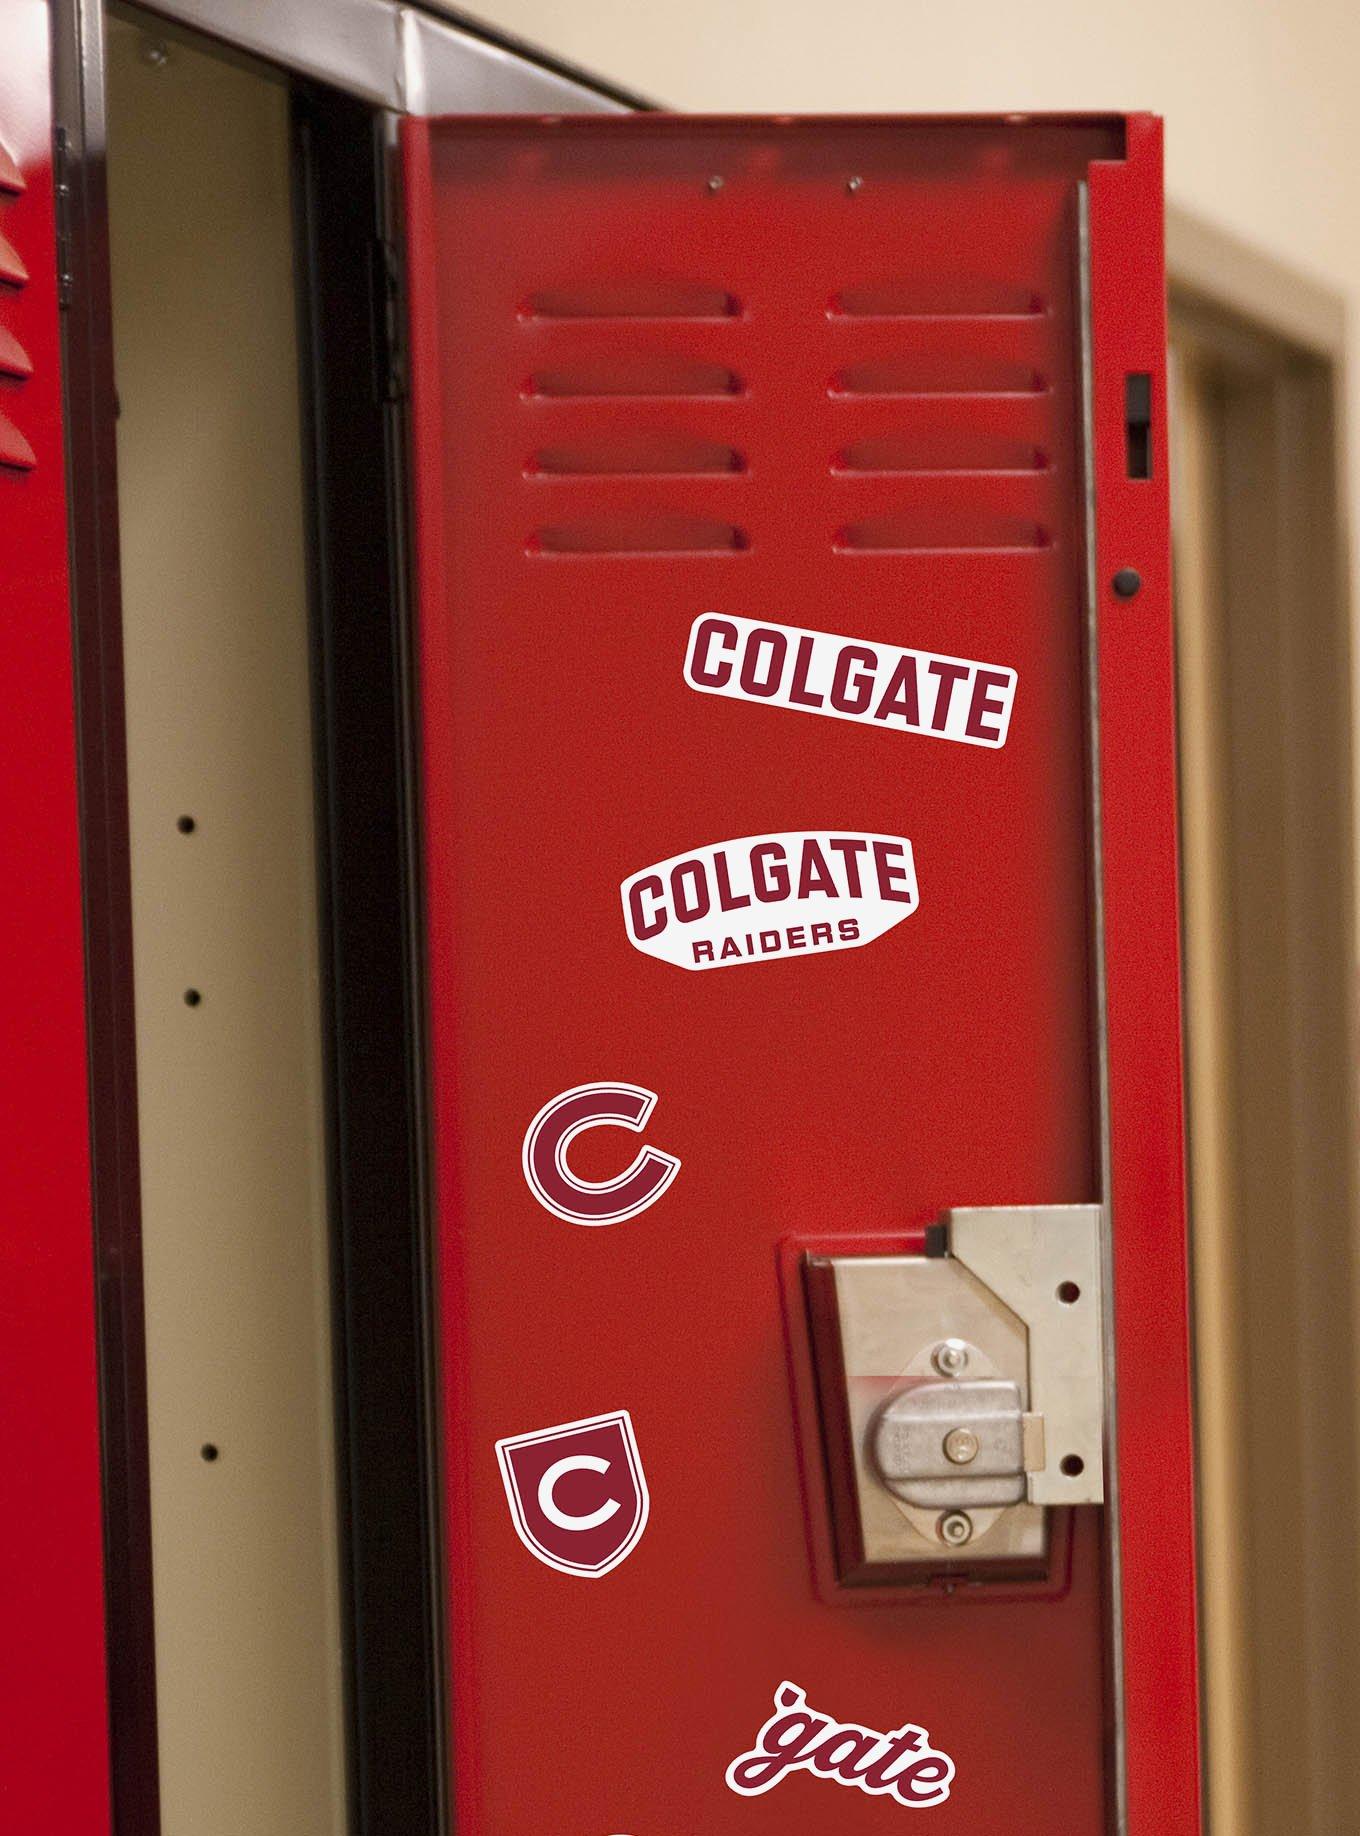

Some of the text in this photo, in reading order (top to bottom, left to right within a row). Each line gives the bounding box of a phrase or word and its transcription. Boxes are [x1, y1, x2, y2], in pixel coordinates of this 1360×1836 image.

[691, 619, 1011, 742] COLGATE
[629, 839, 912, 942] COLGATE
[692, 919, 860, 964] RAIDERS
[528, 1087, 675, 1221] C
[538, 1456, 622, 1531] C
